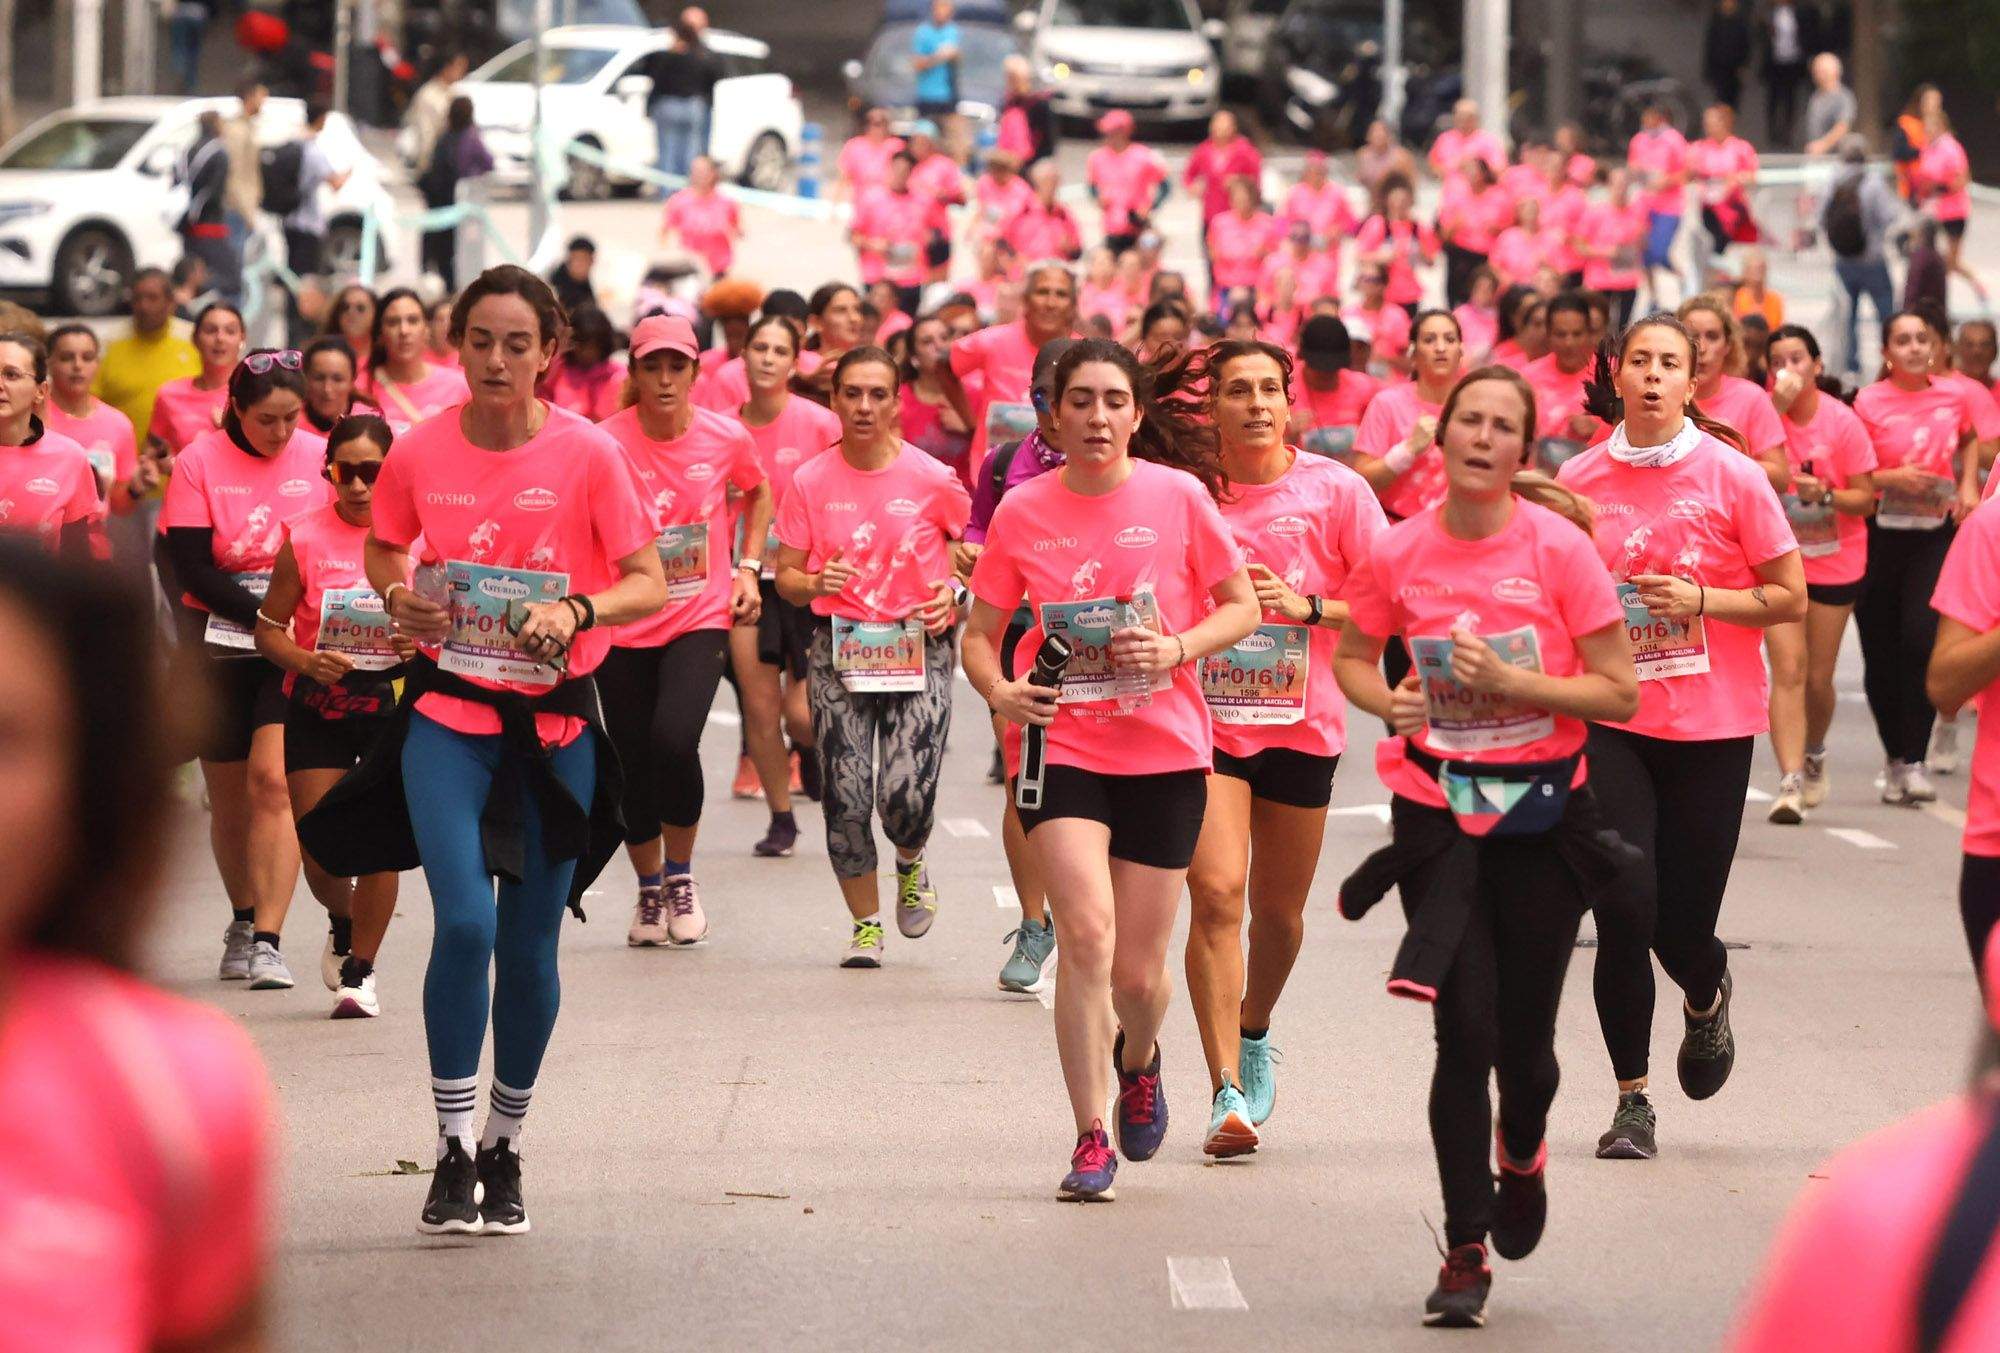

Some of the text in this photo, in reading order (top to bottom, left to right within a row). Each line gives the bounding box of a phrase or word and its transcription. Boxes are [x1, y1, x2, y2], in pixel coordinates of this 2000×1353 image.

[427, 492, 477, 506] OYSHO
[1033, 536, 1078, 552] OYSHO
[350, 624, 385, 639] 016
[1629, 622, 1669, 642] 016
[861, 645, 895, 659] 016
[1639, 643, 1658, 652] 1314
[1665, 648, 1696, 658] BARCELONA
[450, 656, 484, 669] OYSHO
[1230, 667, 1273, 685] 016
[1066, 686, 1103, 697] OYSHO
[1240, 689, 1260, 697] 1596
[1264, 698, 1294, 706] BARCELONA
